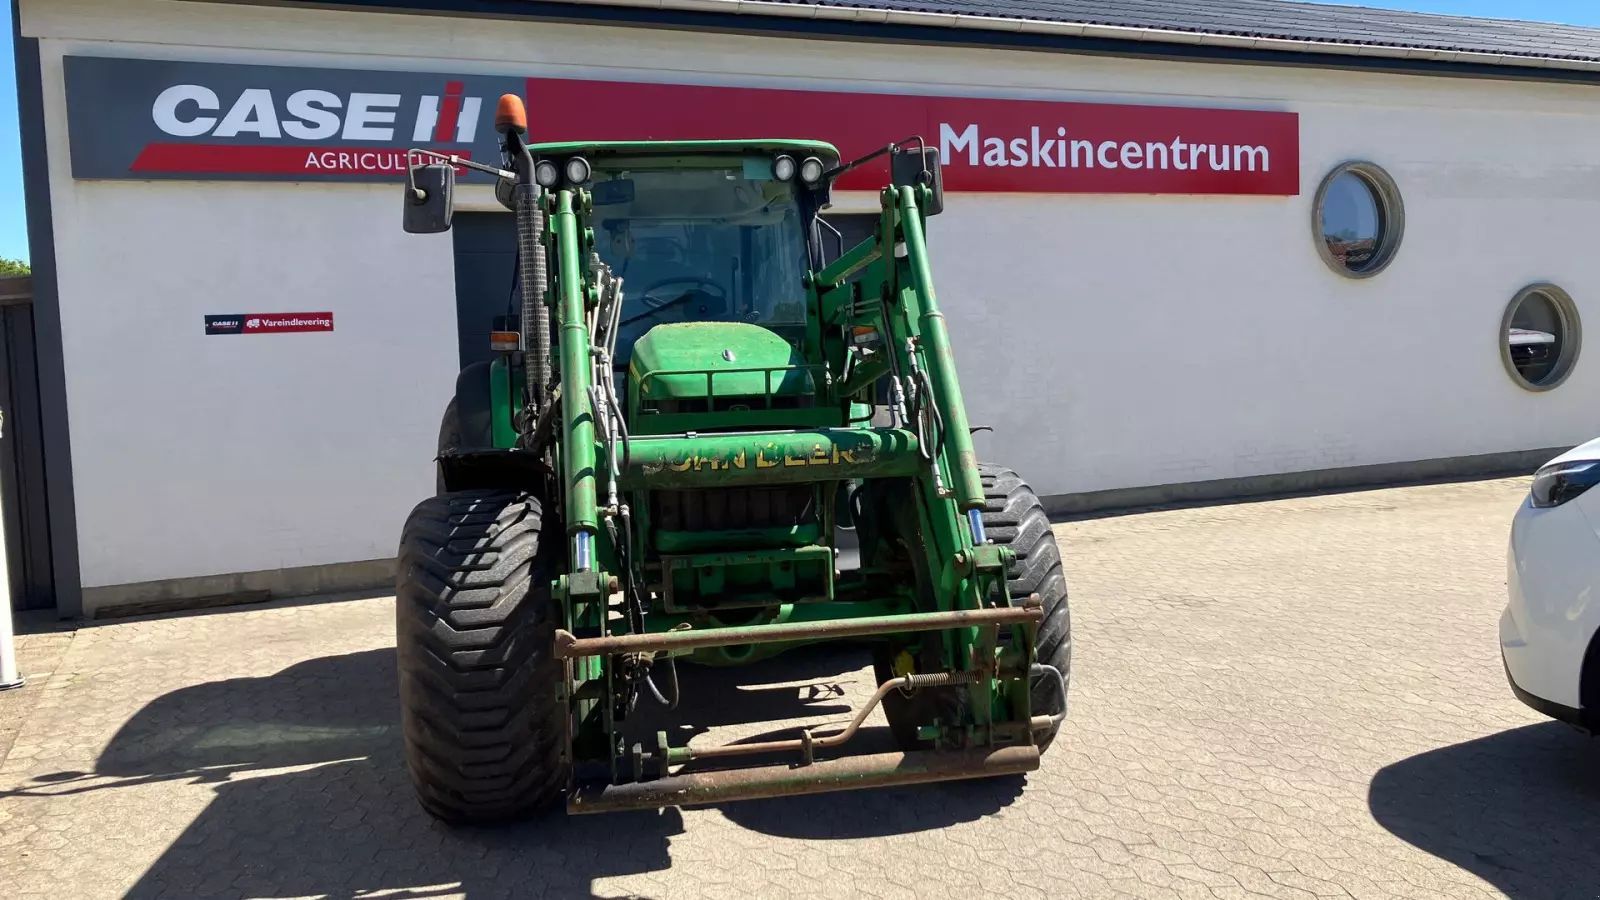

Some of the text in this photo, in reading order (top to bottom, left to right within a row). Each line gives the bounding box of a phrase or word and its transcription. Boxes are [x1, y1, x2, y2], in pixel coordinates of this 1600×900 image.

[152, 84, 401, 142] CASE
[304, 151, 461, 171] AGRICULU
[939, 122, 1270, 172] Maskincentrum
[261, 318, 330, 327] Vareindlevering
